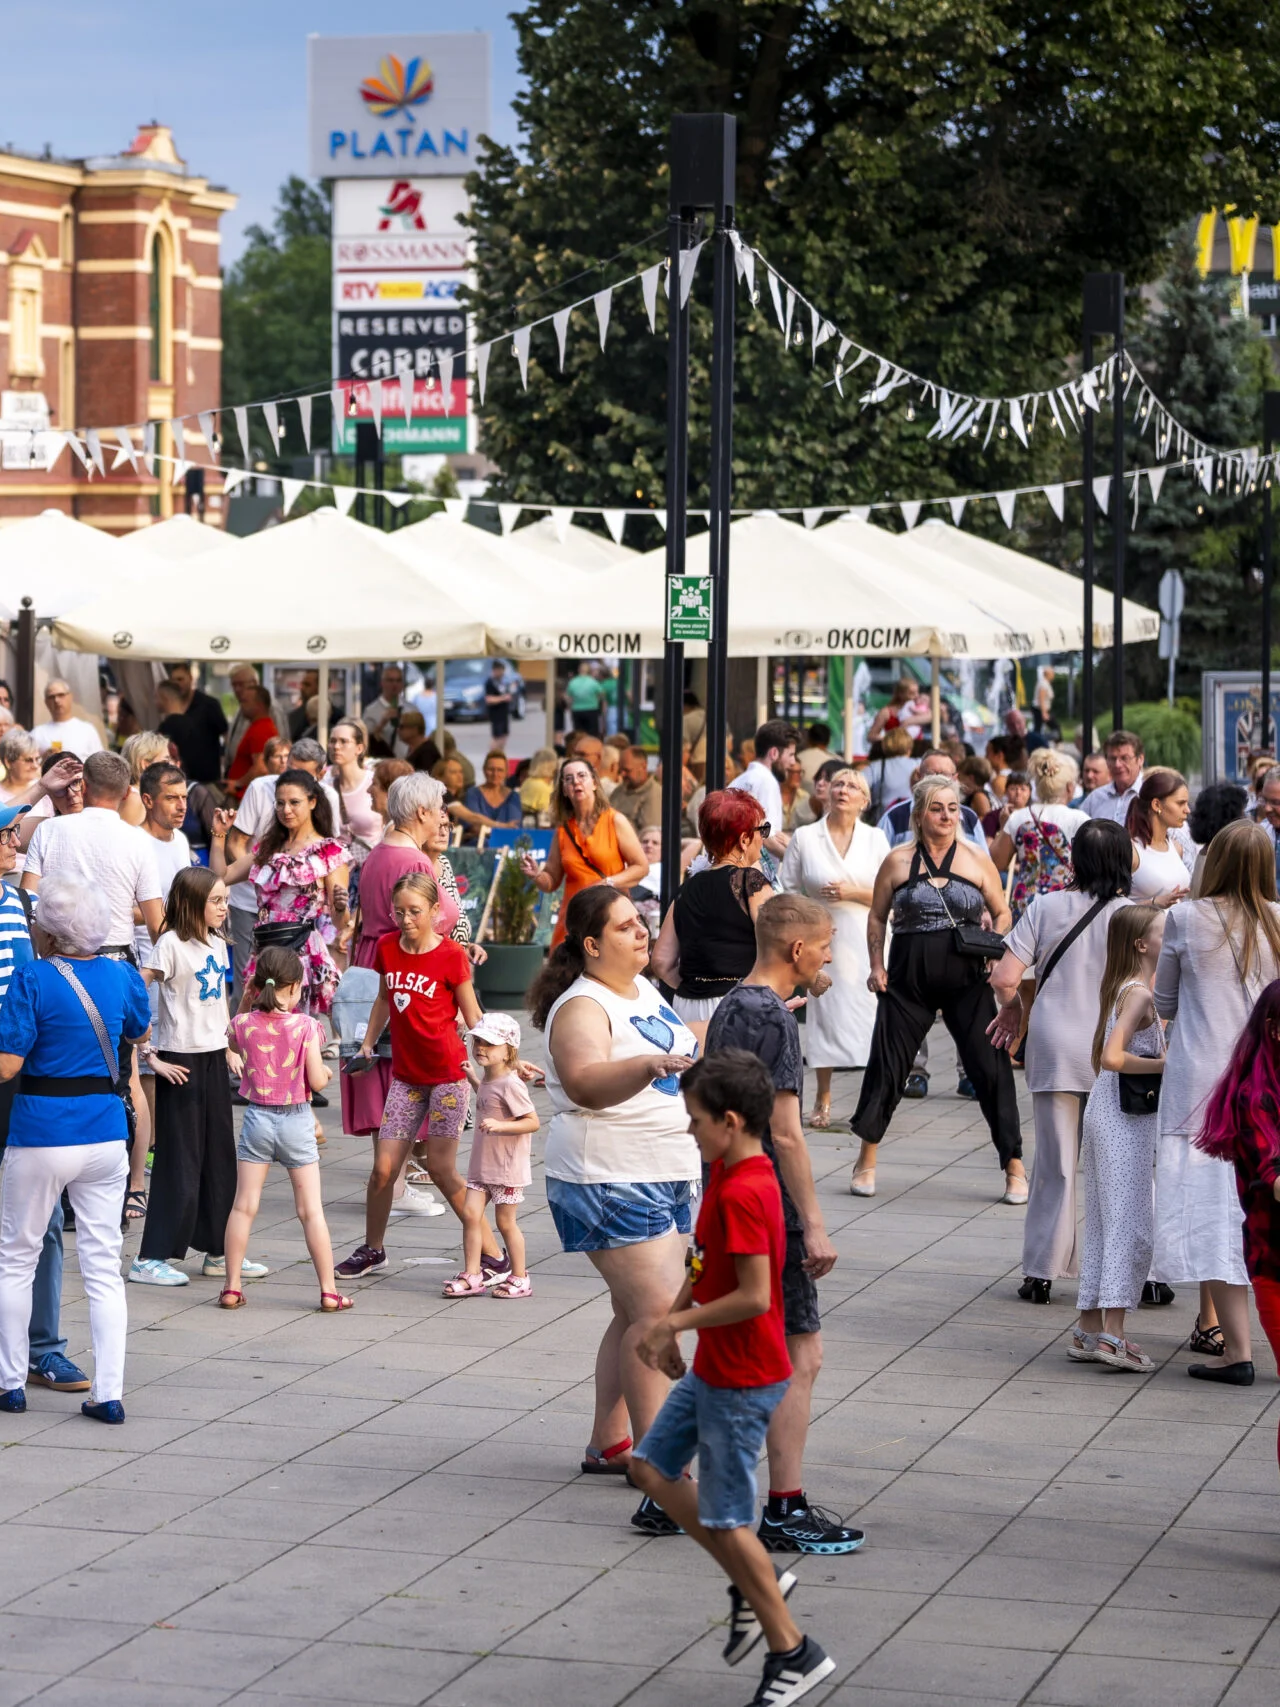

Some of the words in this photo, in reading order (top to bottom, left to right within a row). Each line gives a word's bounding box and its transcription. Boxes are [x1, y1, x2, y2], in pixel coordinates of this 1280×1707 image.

[329, 128, 468, 159] PLATAN
[342, 281, 378, 300] RTV
[340, 316, 463, 336] RESERVED
[559, 633, 641, 654] OKOCIM
[827, 628, 911, 649] OKOCIM
[385, 971, 438, 999] OLSKA
